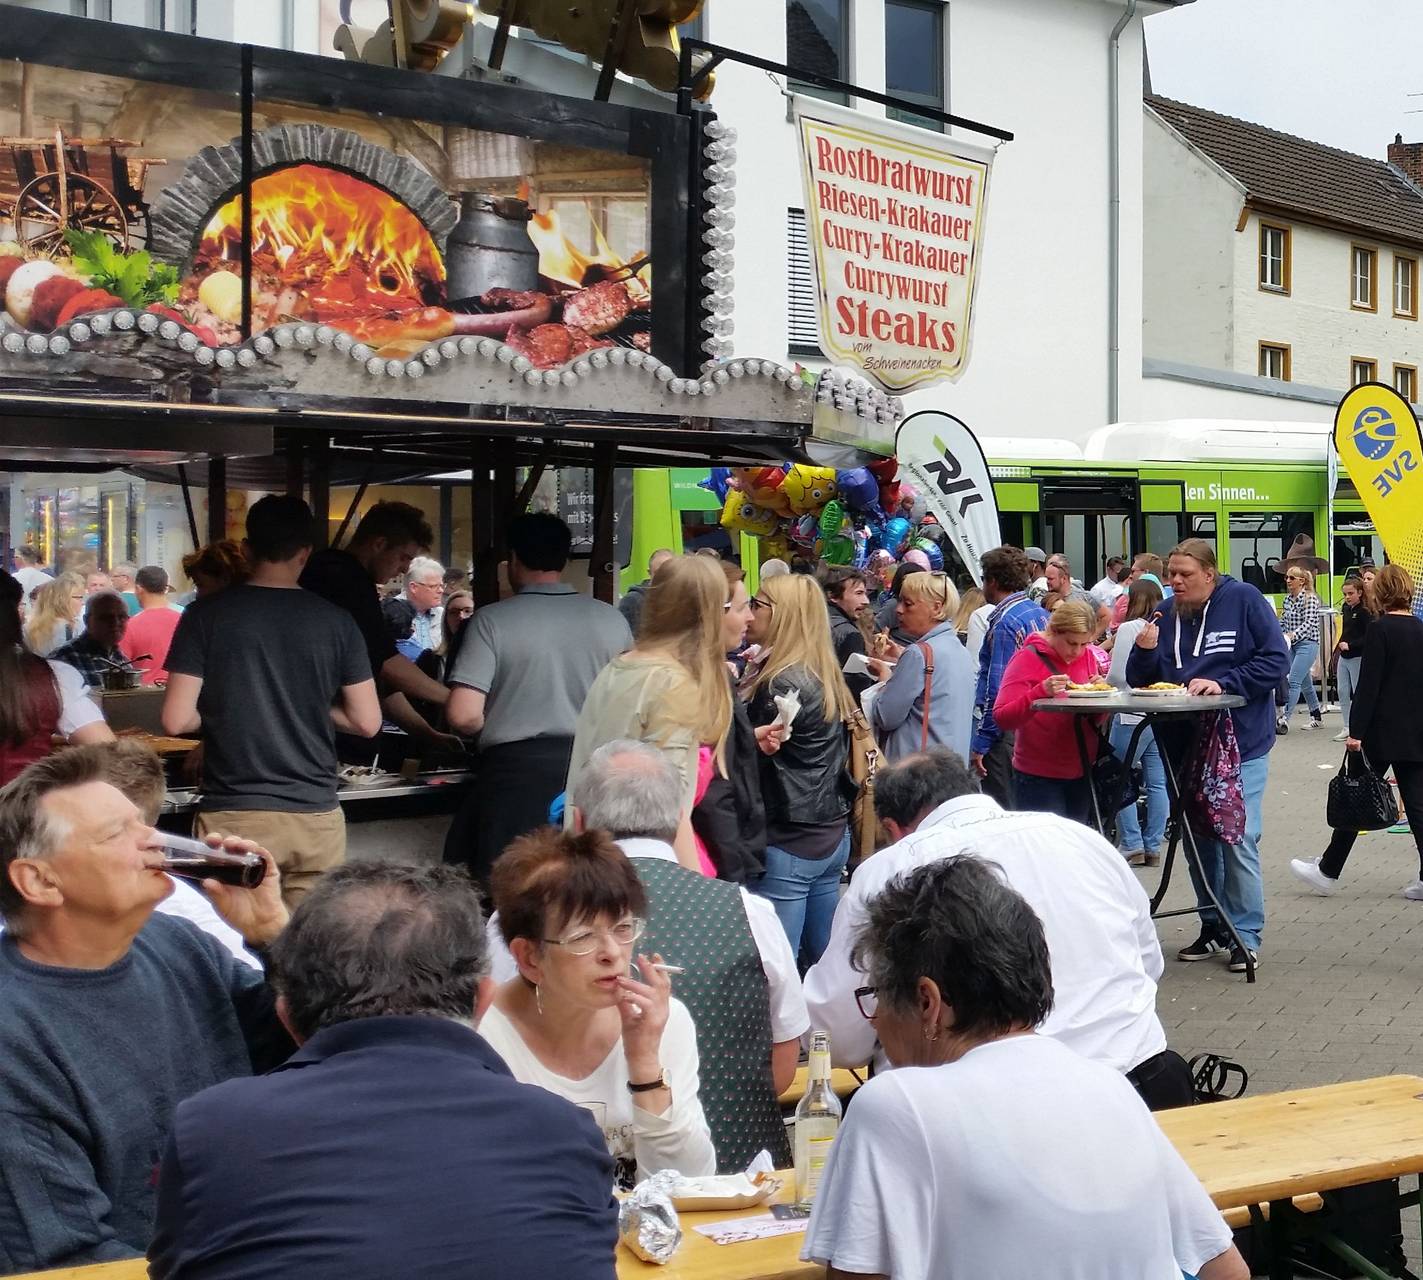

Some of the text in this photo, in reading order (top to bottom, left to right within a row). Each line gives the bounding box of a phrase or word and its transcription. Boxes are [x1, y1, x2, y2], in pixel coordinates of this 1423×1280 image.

[816, 136, 973, 206] Rostbratwurst
[818, 180, 972, 241] Riesen-Krakauer
[823, 219, 968, 276] Curry-Krakauer
[844, 260, 948, 307] Currywurst
[835, 296, 957, 353] Steaks
[853, 341, 872, 353] vom
[863, 356, 942, 370] Schweinenacken
[1184, 481, 1270, 501] len Sinnen...
